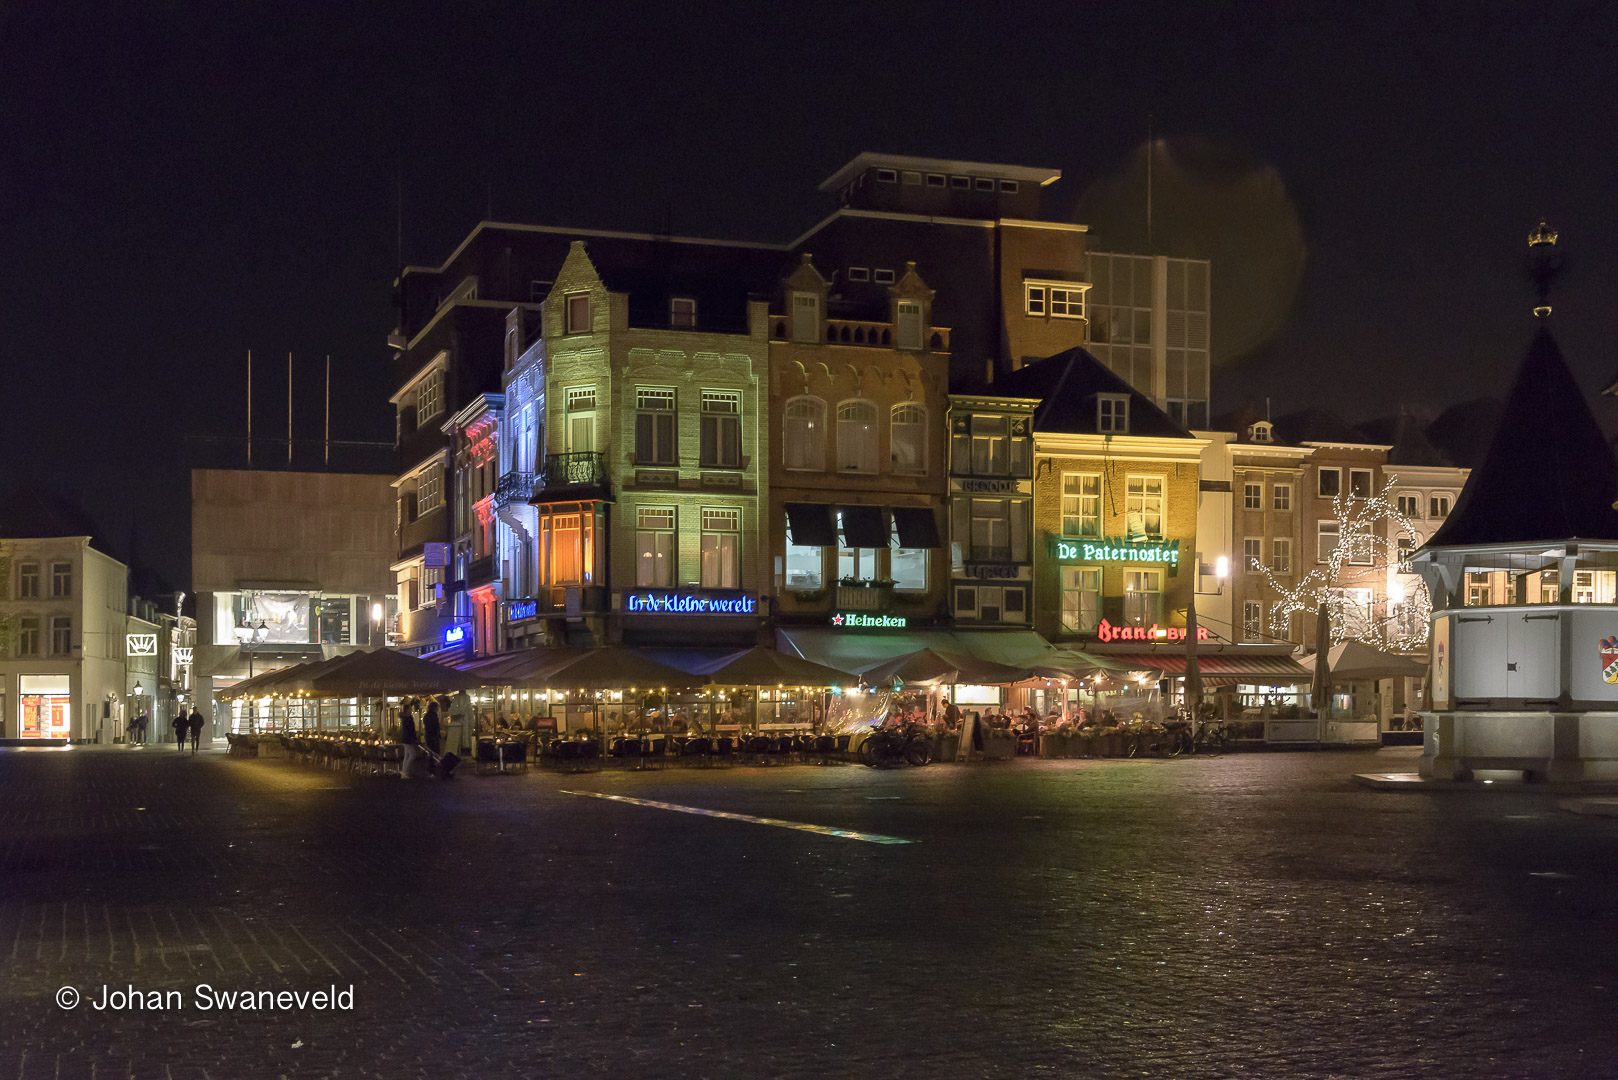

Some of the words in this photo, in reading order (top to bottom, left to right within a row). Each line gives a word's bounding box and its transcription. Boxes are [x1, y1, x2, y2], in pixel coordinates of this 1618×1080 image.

[1057, 543, 1077, 559] De
[1083, 544, 1179, 562] Paternoster
[628, 595, 644, 612] In
[646, 593, 661, 612] de
[709, 595, 757, 613] werelt
[844, 614, 906, 628] Heineken
[1098, 618, 1158, 642] Brand
[1167, 628, 1209, 640] BIR
